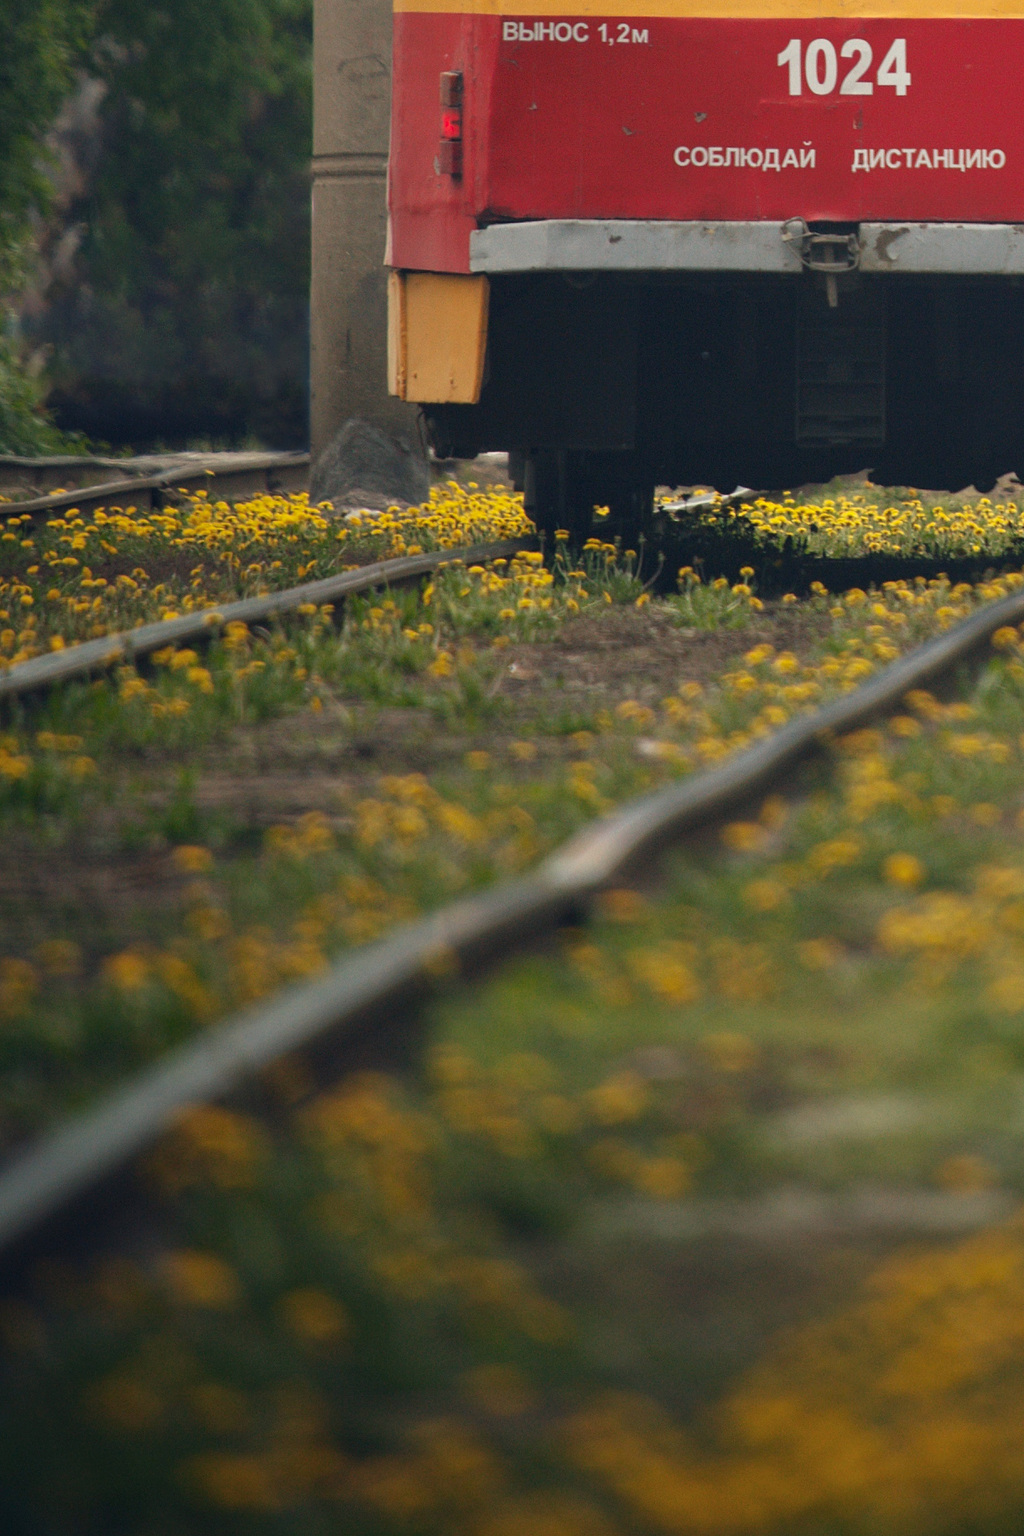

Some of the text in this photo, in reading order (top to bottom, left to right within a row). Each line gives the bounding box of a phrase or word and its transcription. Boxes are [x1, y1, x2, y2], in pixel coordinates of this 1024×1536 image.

[502, 21, 589, 43] ВЫНОС
[776, 37, 912, 96] 1024
[673, 140, 1007, 172] СОБЛЮДАЙ ДИСТАНЦИЮ
